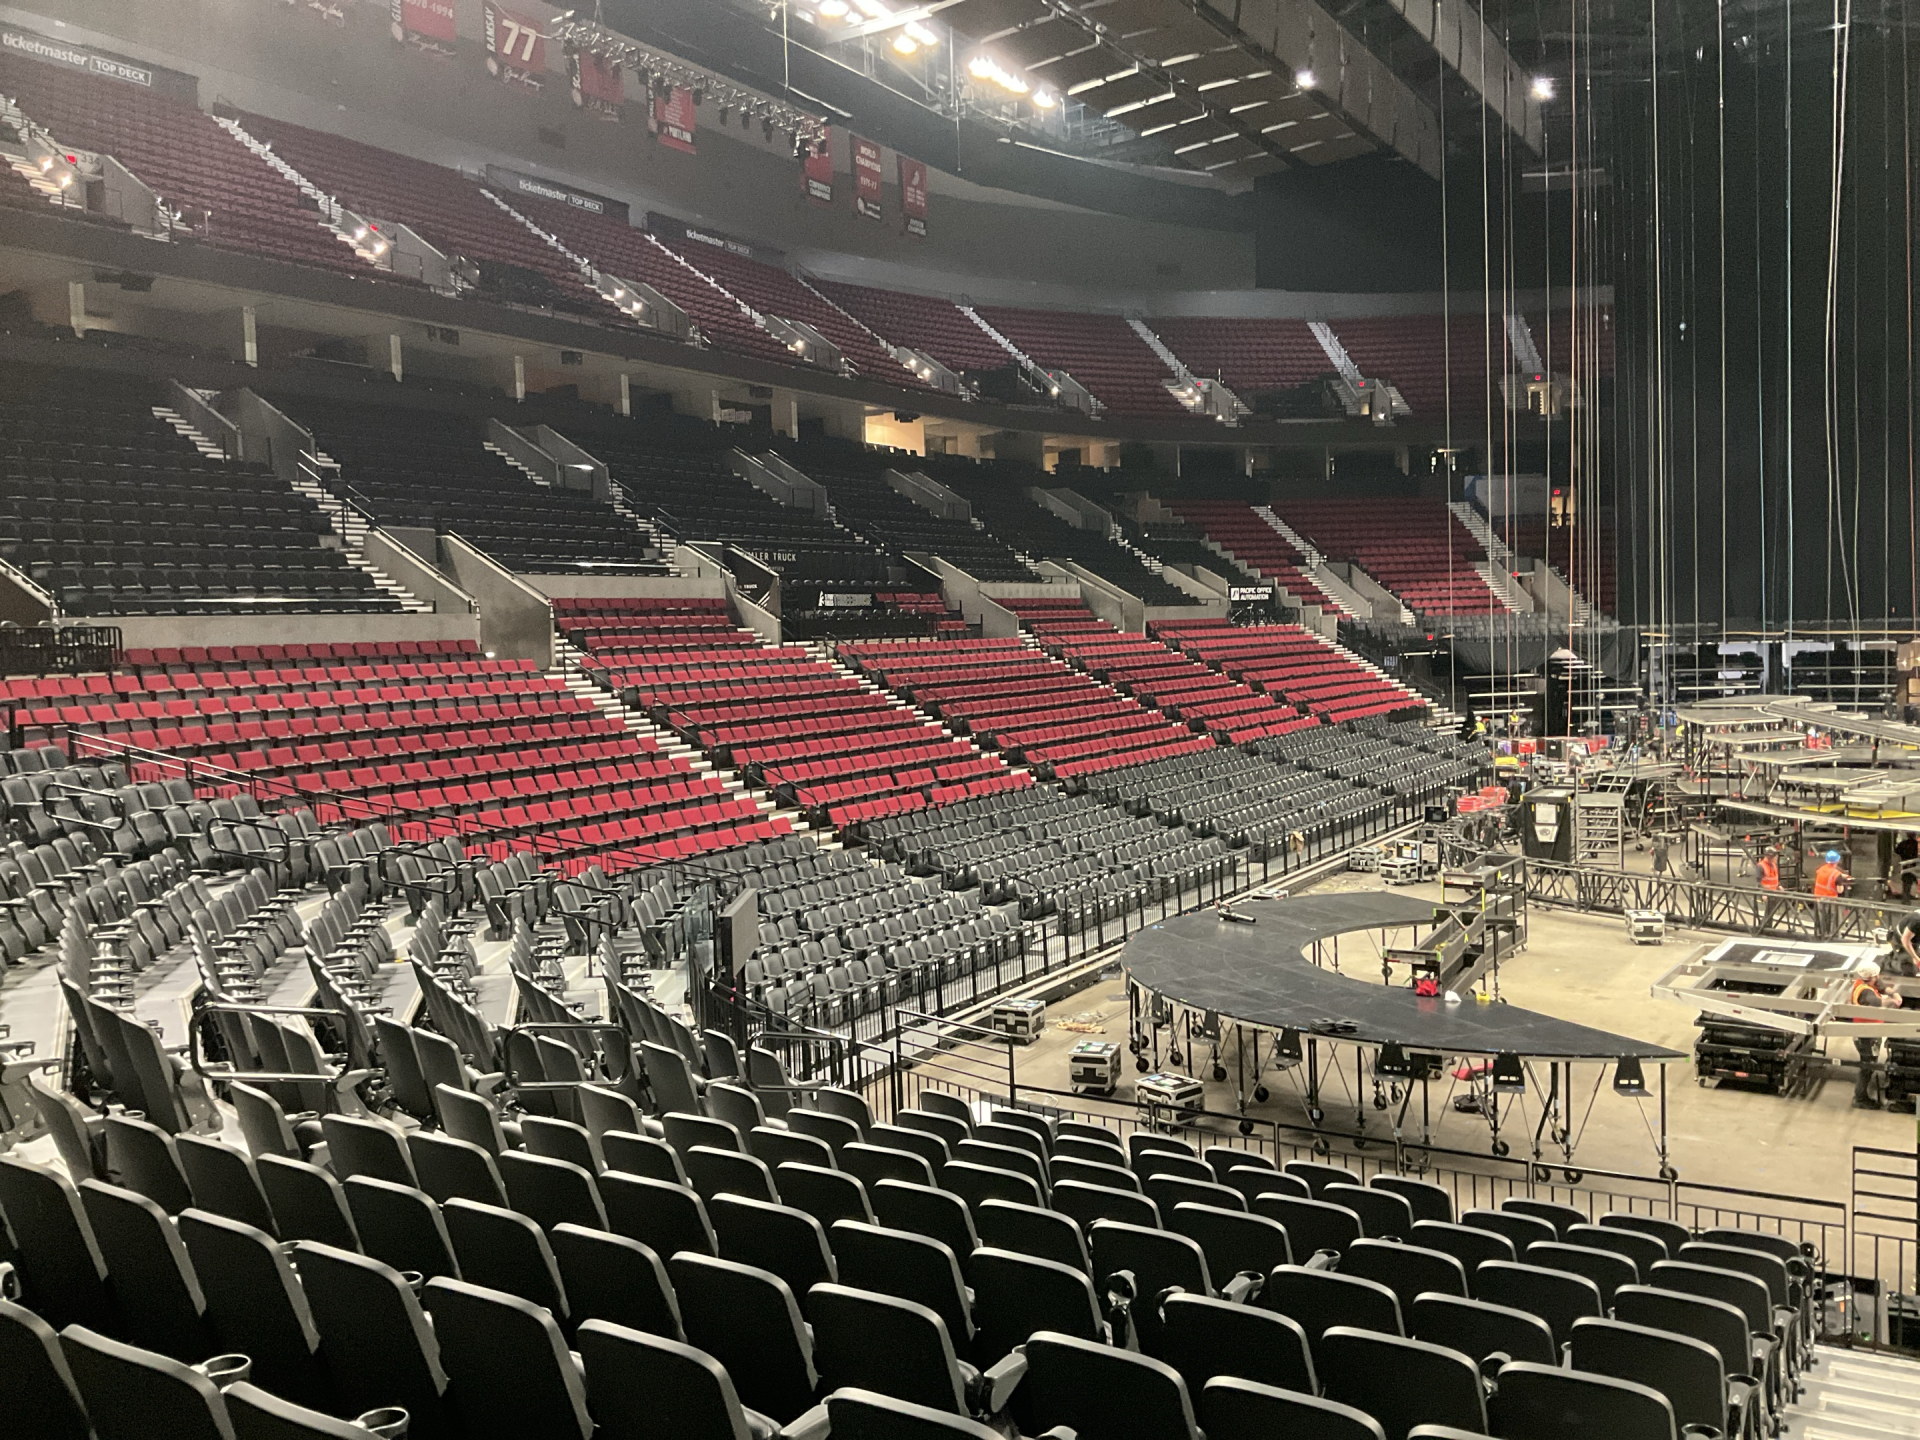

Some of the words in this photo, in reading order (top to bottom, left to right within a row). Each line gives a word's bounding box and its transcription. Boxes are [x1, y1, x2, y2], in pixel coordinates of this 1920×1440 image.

[485, 6, 496, 53] RAMSAY
[502, 19, 537, 62] 77
[2, 32, 88, 66] ticketmaster
[96, 60, 117, 72] TOP
[118, 67, 146, 82] DECK
[519, 179, 567, 201] ticketmaster
[571, 196, 583, 206] TOP
[584, 200, 600, 211] DECK
[686, 229, 724, 247] ticketmaster
[772, 552, 797, 562] TRUCK
